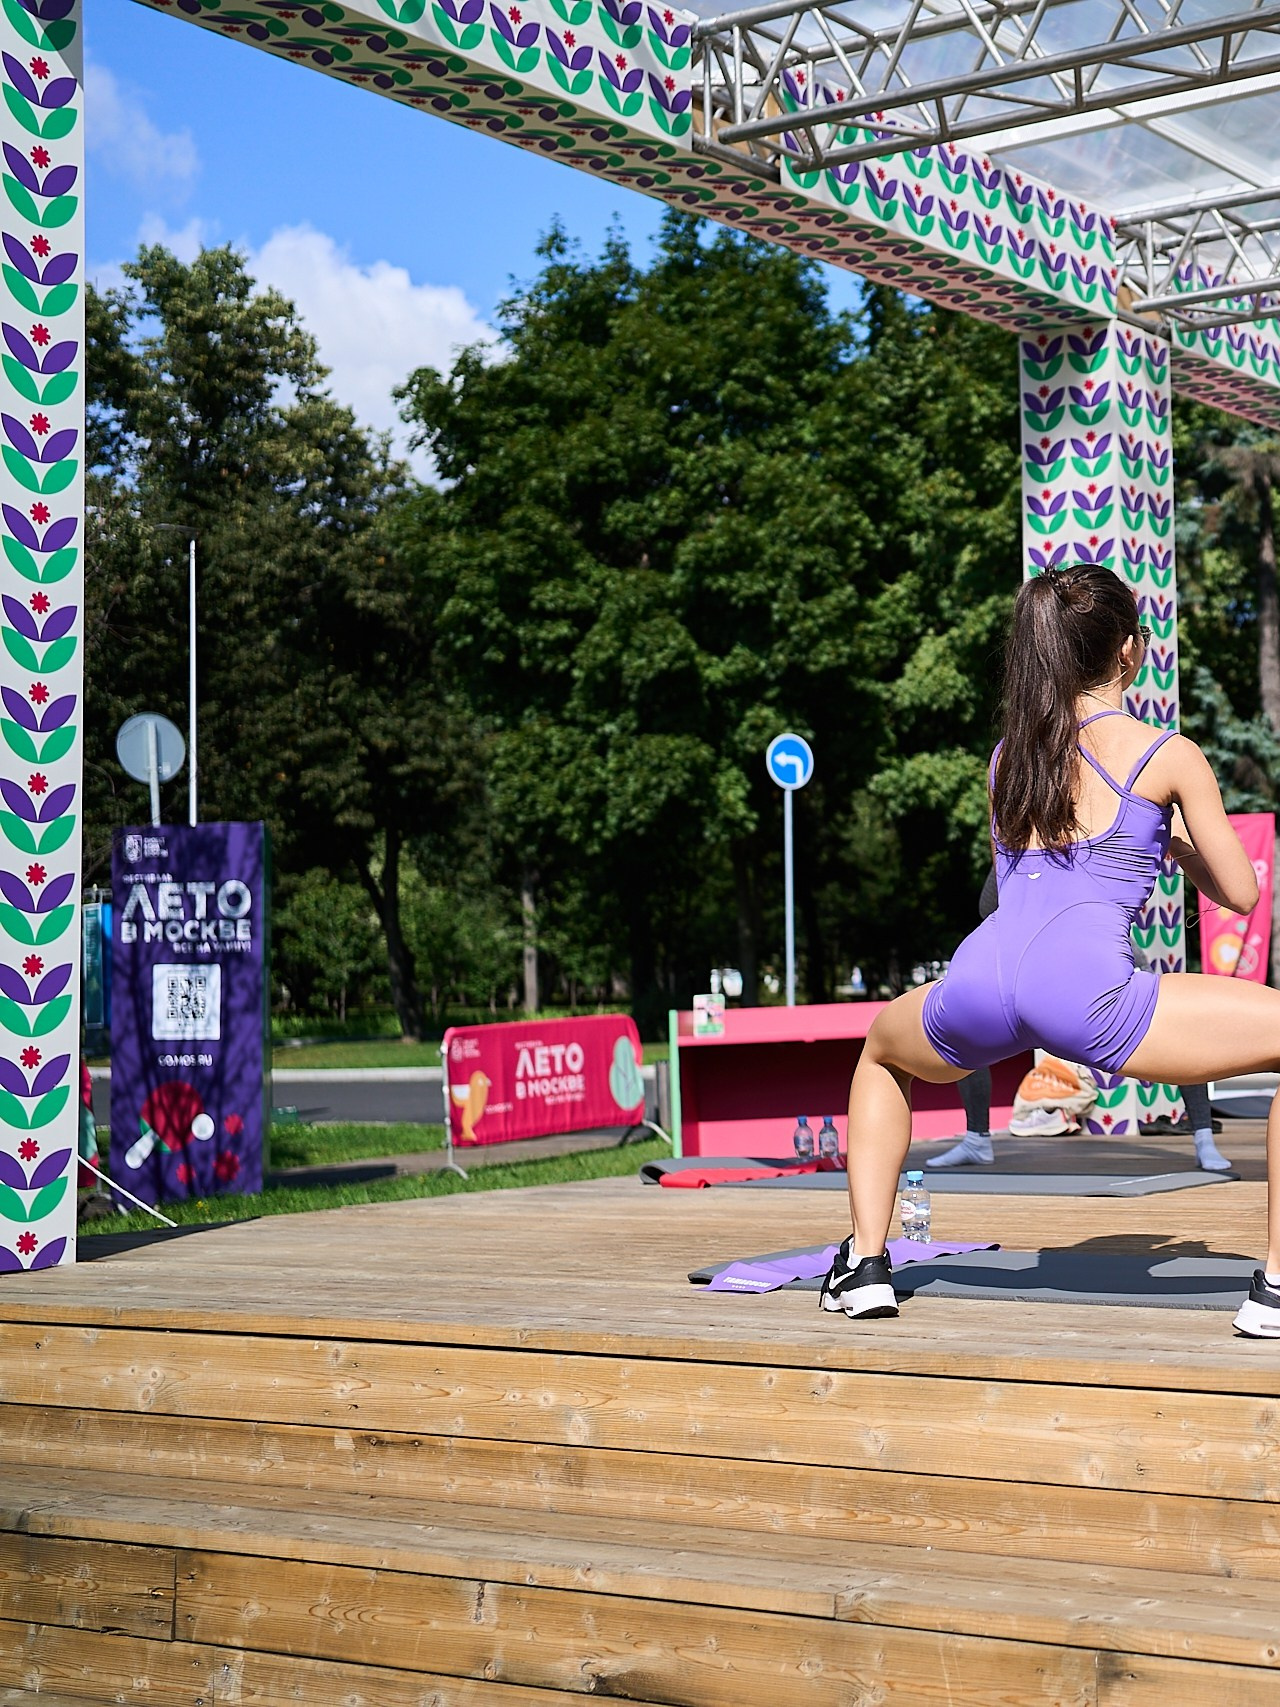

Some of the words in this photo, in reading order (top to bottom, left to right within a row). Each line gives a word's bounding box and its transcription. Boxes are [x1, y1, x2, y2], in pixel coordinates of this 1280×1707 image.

[121, 879, 252, 921] ЛЕТО
[121, 921, 138, 943] В
[143, 918, 252, 943] МОСКВЕ
[515, 1042, 585, 1079] ЛЕТО
[515, 1081, 527, 1100] В
[527, 1074, 586, 1099] МОСКВЕ
